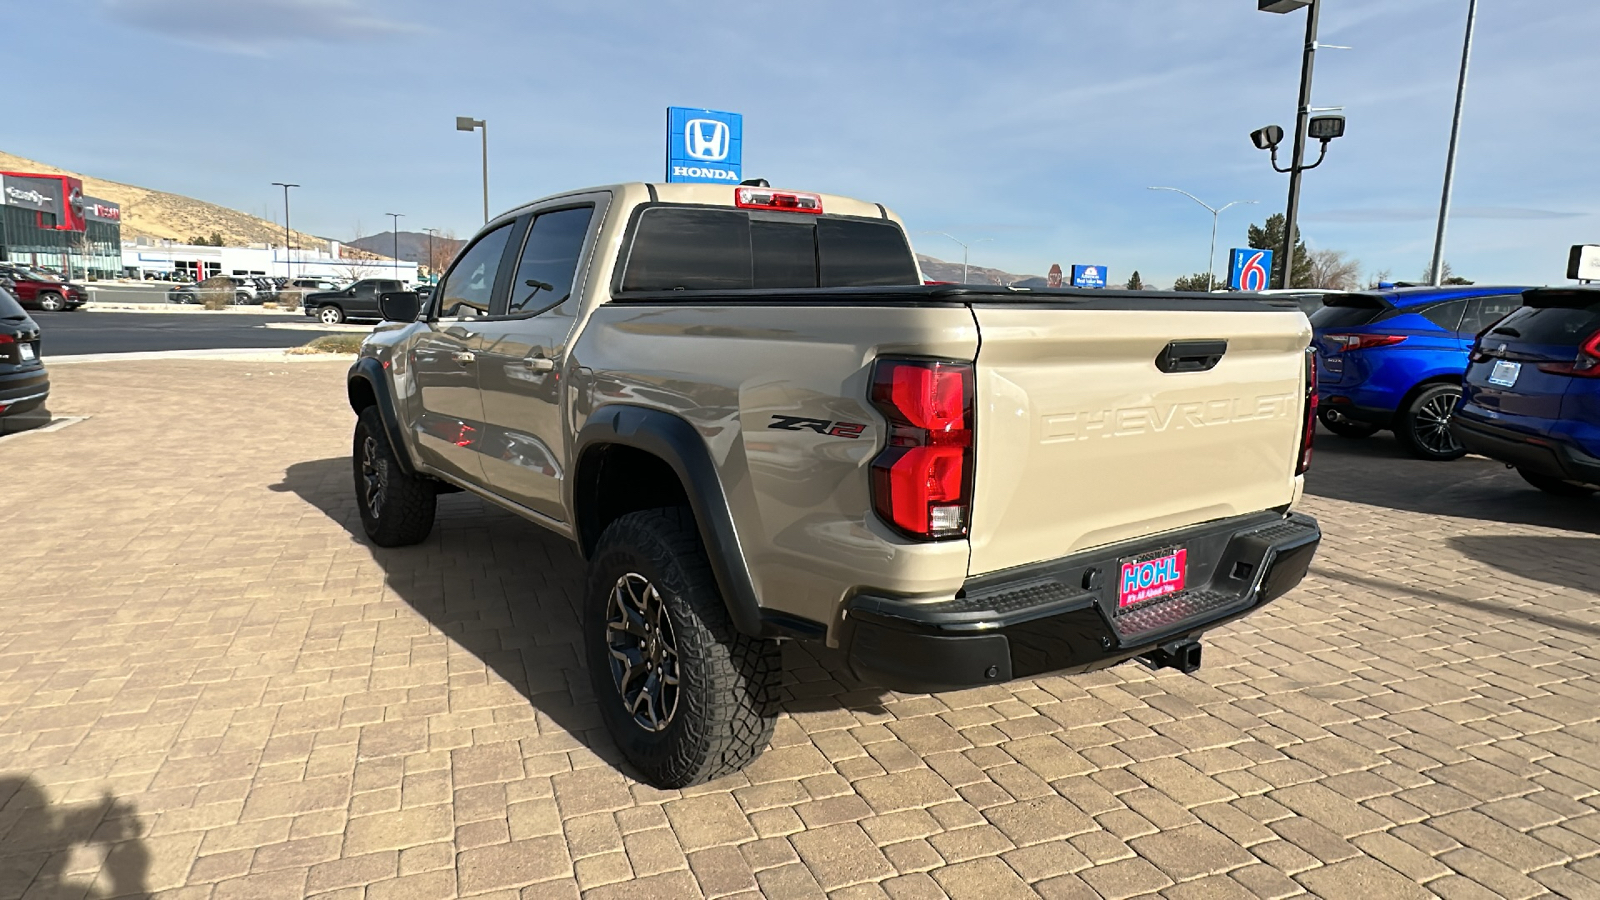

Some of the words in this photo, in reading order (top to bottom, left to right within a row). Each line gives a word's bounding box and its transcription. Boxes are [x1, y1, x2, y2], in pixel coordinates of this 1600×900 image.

[673, 165, 739, 181] HONDA
[1240, 251, 1267, 291] 6
[767, 414, 867, 439] ZR2
[1039, 391, 1296, 445] CHEVROLET
[1123, 556, 1180, 593] HOHL
